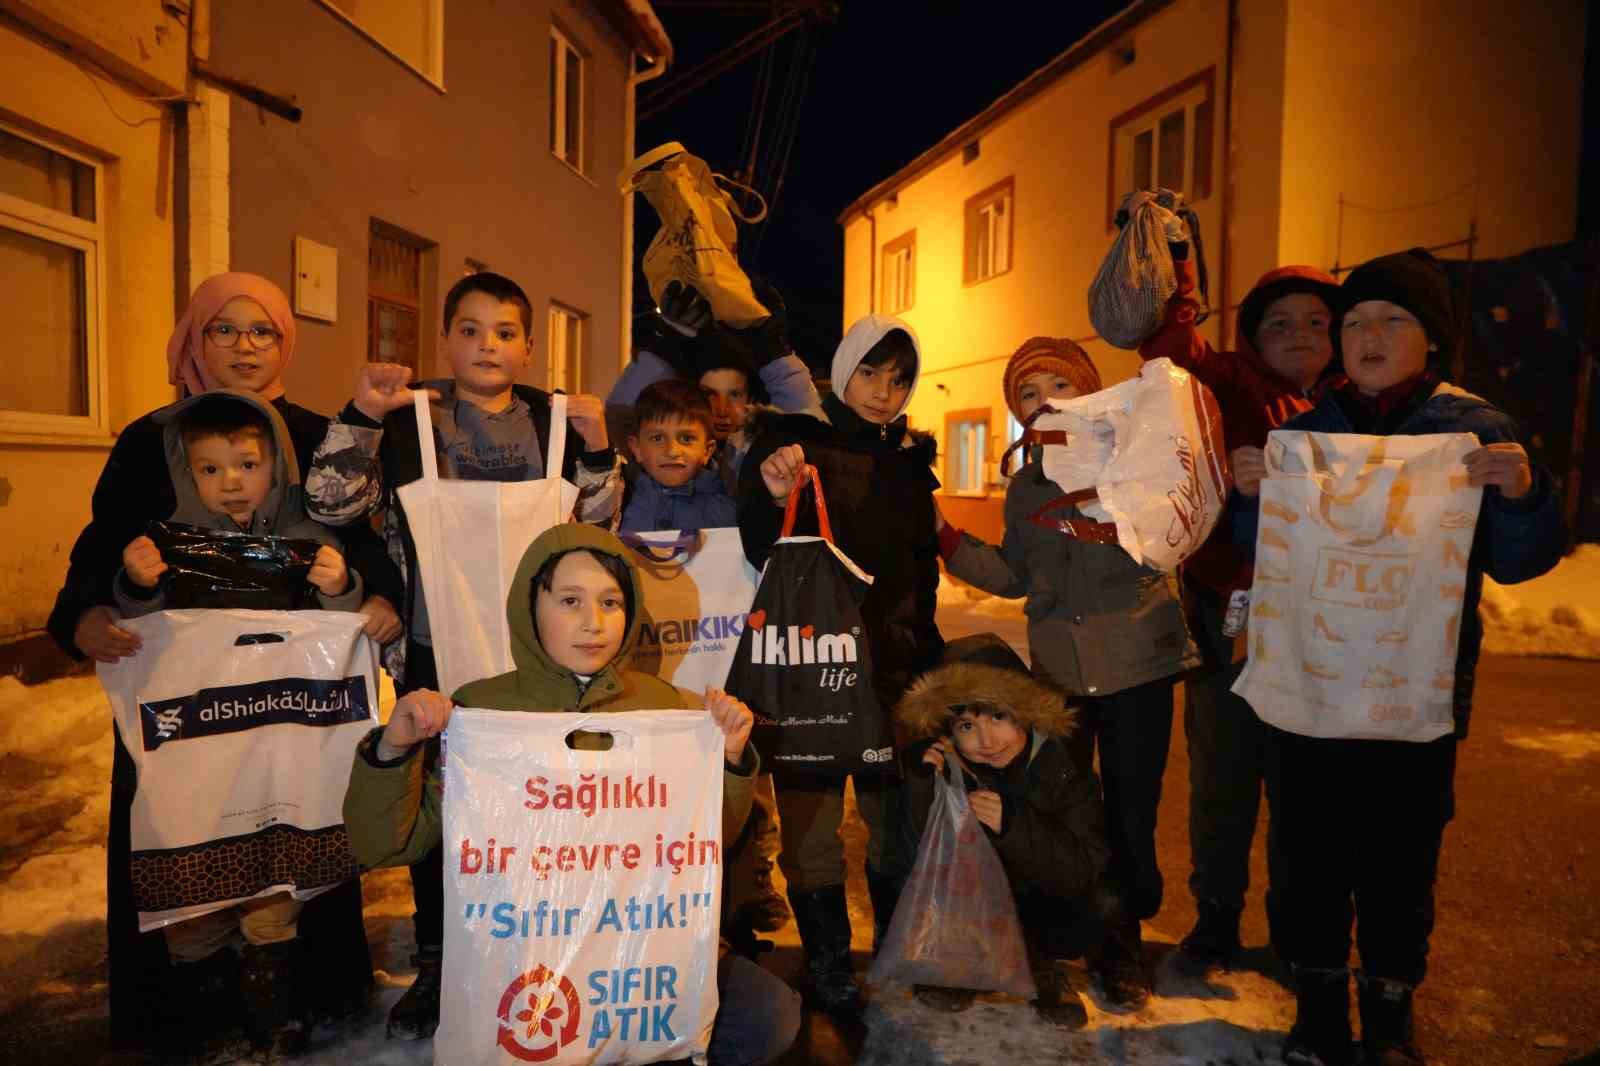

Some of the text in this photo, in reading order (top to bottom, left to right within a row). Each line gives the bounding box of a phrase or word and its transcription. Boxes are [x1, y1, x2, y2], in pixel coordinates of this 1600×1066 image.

[819, 667, 857, 692] life
[524, 773, 668, 817] Sağlıklı
[460, 832, 719, 880] bir çevre için
[588, 965, 678, 1005] SIFIR
[587, 1004, 677, 1049] ATIK
